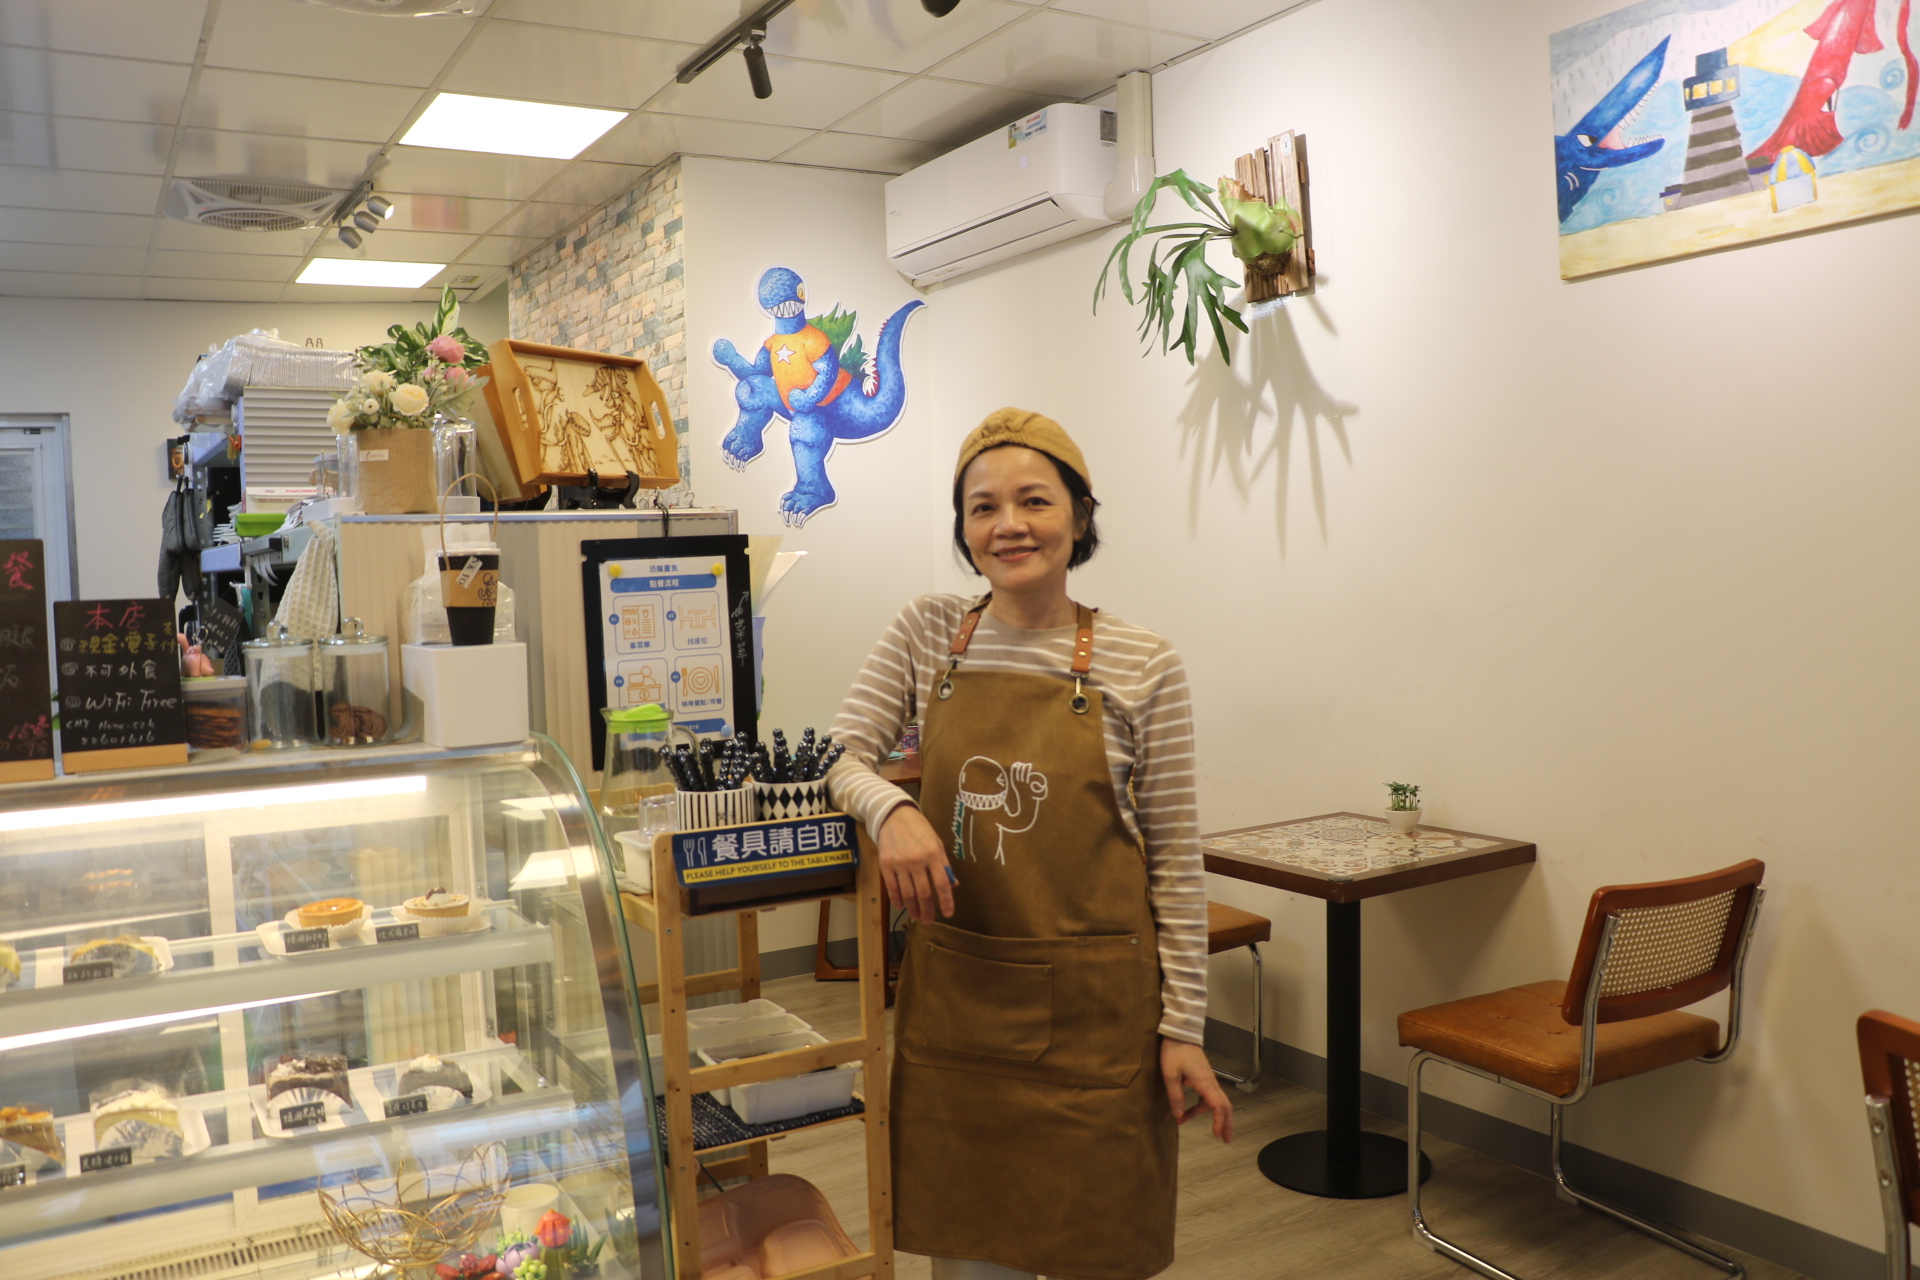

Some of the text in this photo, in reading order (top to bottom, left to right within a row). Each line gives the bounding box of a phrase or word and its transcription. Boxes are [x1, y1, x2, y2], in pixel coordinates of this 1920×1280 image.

[85, 602, 146, 630] 本店
[84, 658, 158, 681] 不可外食
[711, 822, 849, 863] 餐具請自取
[685, 852, 851, 881] PLEASE HELP YOURSELF TO THE TABLEWARE
